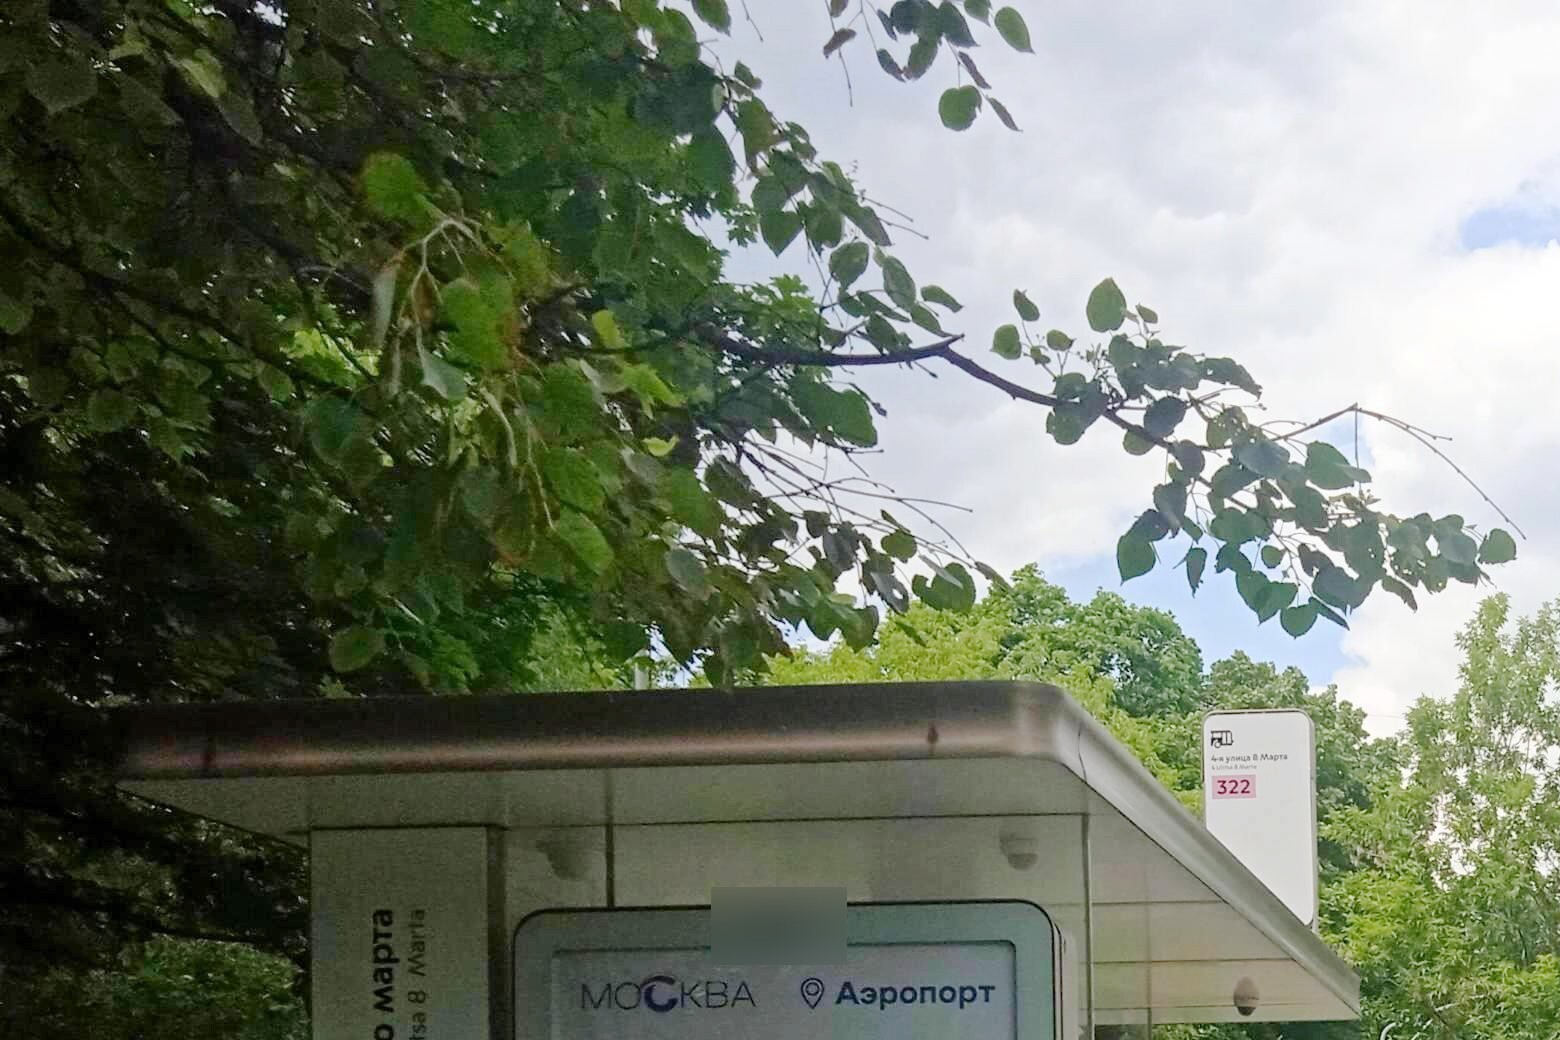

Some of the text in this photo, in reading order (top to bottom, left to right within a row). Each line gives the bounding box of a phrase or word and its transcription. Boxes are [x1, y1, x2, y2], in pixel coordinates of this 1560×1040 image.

[1226, 755, 1251, 764] улица
[1260, 753, 1288, 762] Марта
[1217, 779, 1250, 794] 322
[407, 908, 427, 977] Marta
[372, 908, 399, 1012] марта
[407, 990, 427, 1005] 8
[580, 975, 757, 1013] МОСКВА
[835, 981, 996, 1010] Аэропорт
